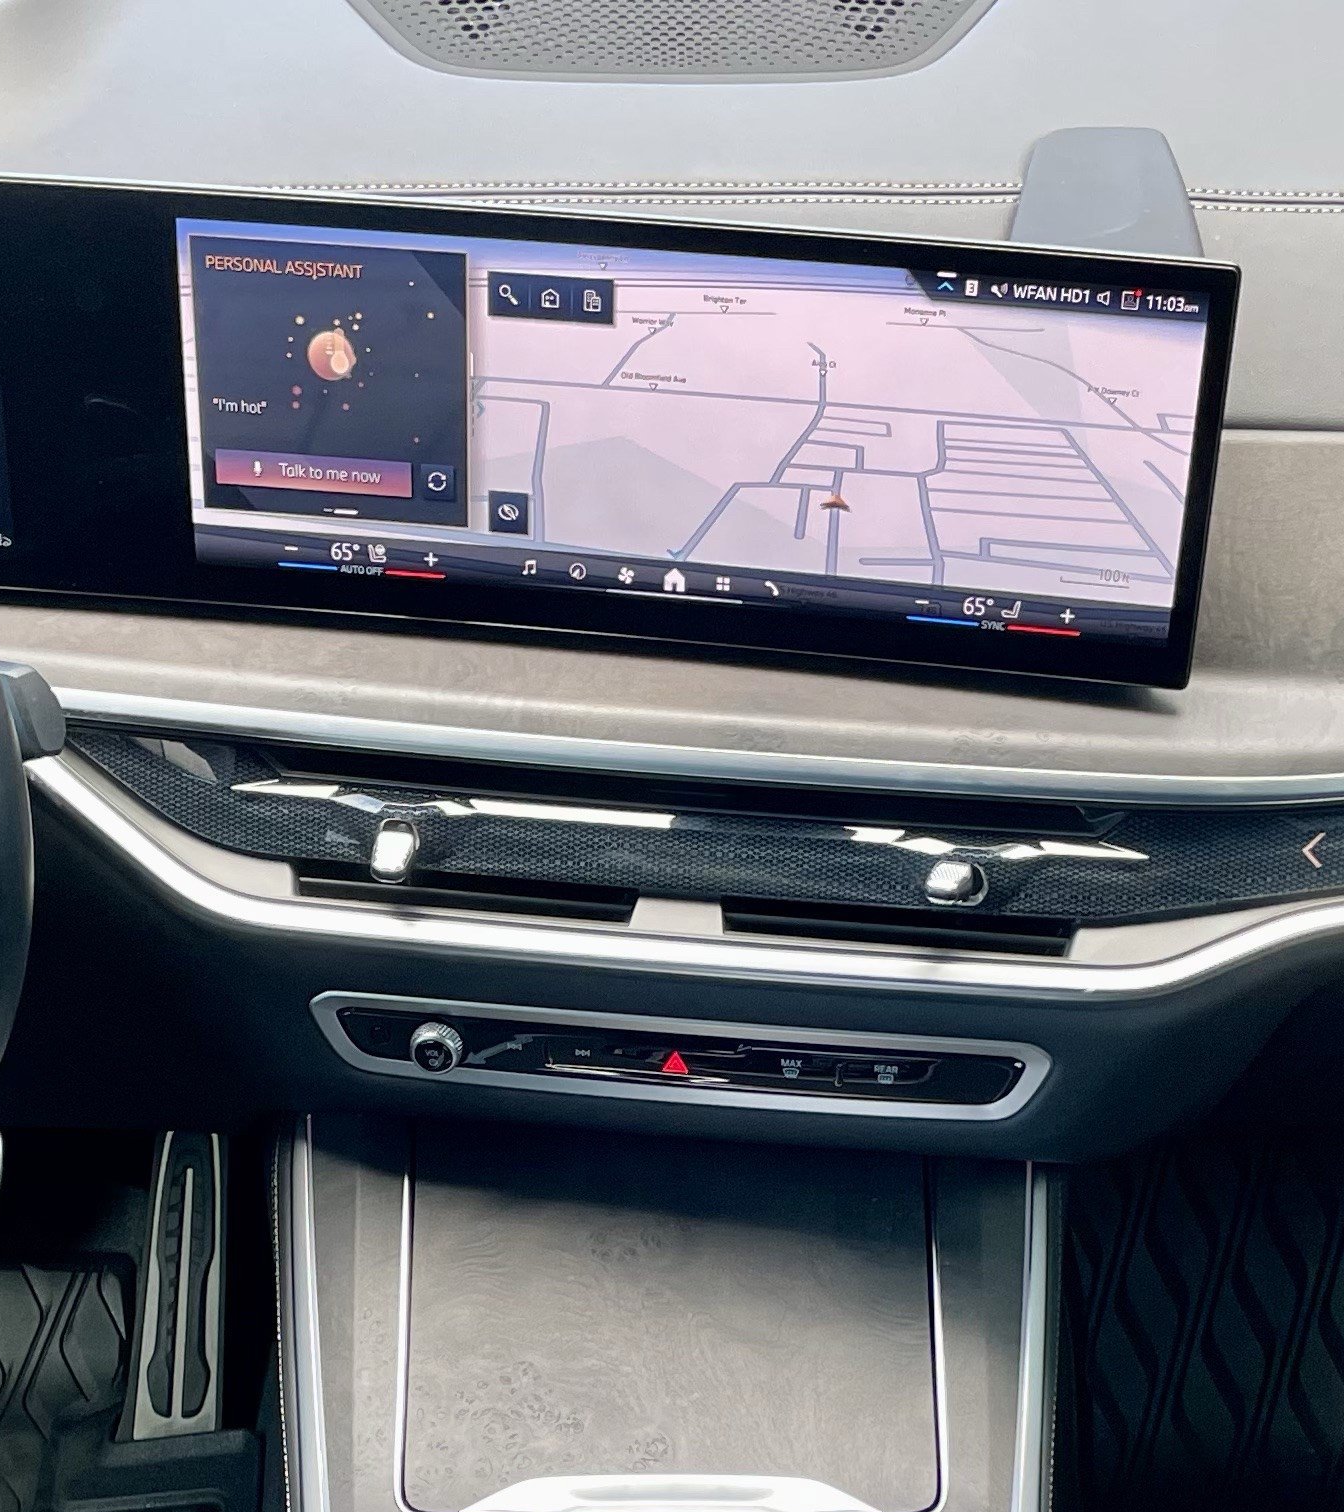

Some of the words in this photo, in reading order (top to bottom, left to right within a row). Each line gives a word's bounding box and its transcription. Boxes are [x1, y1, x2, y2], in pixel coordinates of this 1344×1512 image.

[205, 254, 283, 274] PERSONAL
[285, 260, 363, 279] ASSISTANT
[1013, 283, 1057, 302] WFAN
[1060, 287, 1091, 304] HD1
[278, 462, 306, 478] Talk
[309, 466, 323, 480] to
[326, 469, 348, 482] me
[351, 472, 382, 485] now
[330, 542, 361, 562] 65°
[340, 564, 365, 575] AUTO
[365, 565, 384, 577] OFF
[962, 597, 994, 616] 65°
[980, 619, 1006, 632] SYNC
[780, 1058, 803, 1068] MAX
[873, 1064, 899, 1074] REAR
